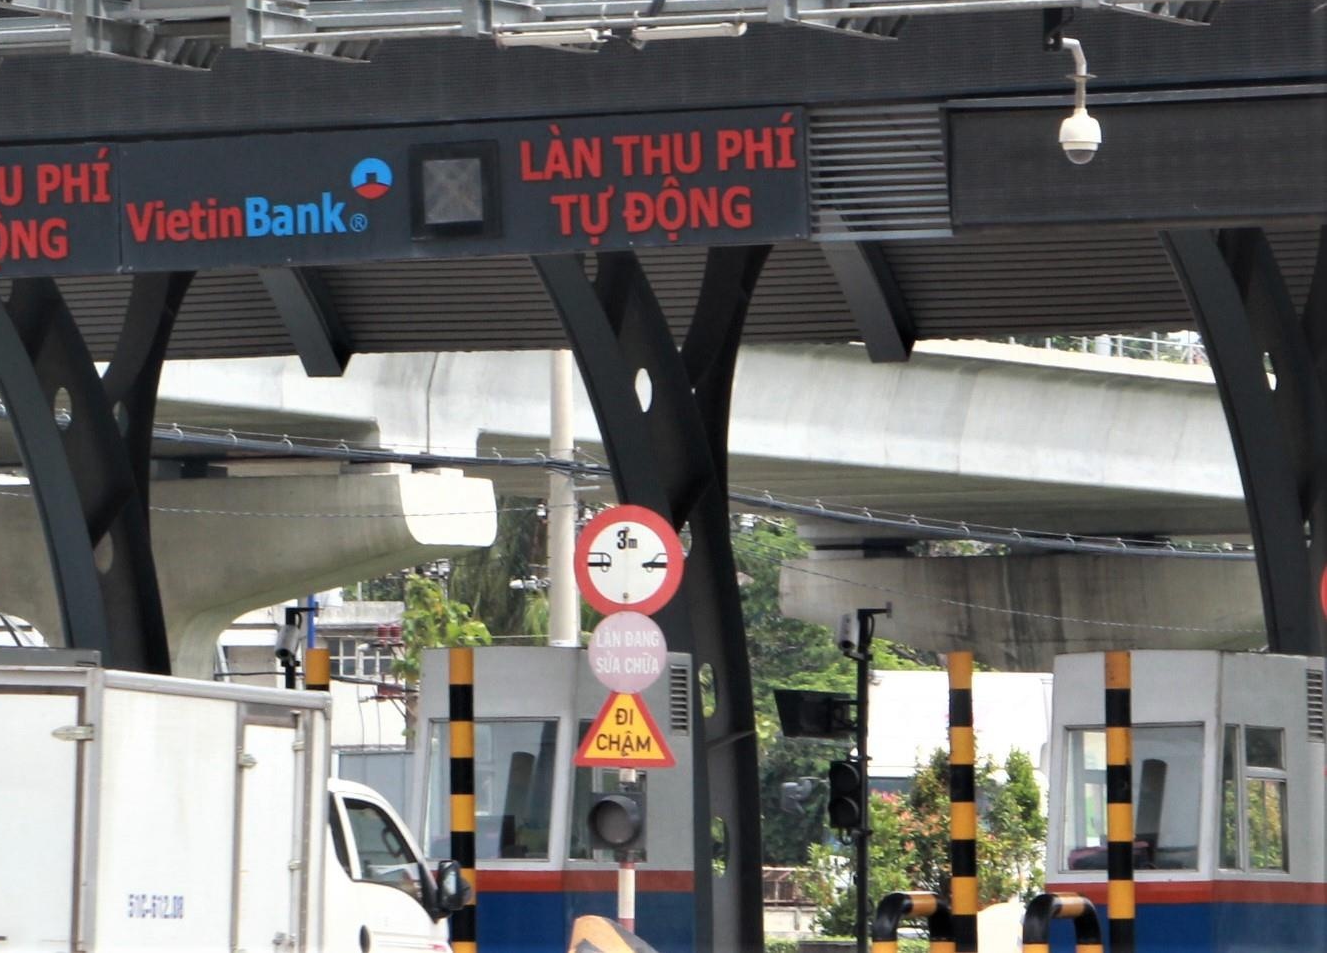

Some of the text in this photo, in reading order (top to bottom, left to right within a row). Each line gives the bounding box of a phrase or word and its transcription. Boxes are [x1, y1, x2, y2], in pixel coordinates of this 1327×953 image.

[520, 112, 798, 182] LÀN THU PHÍ
[36, 147, 112, 205] PHÍ
[126, 192, 347, 244] VietinBank
[551, 176, 752, 245] TỰ ĐỘNG
[596, 625, 659, 648] LÀN ĐANG
[595, 649, 659, 674] SỬA CHỮA
[615, 708, 634, 725] ĐI
[596, 731, 651, 756] CHẬM
